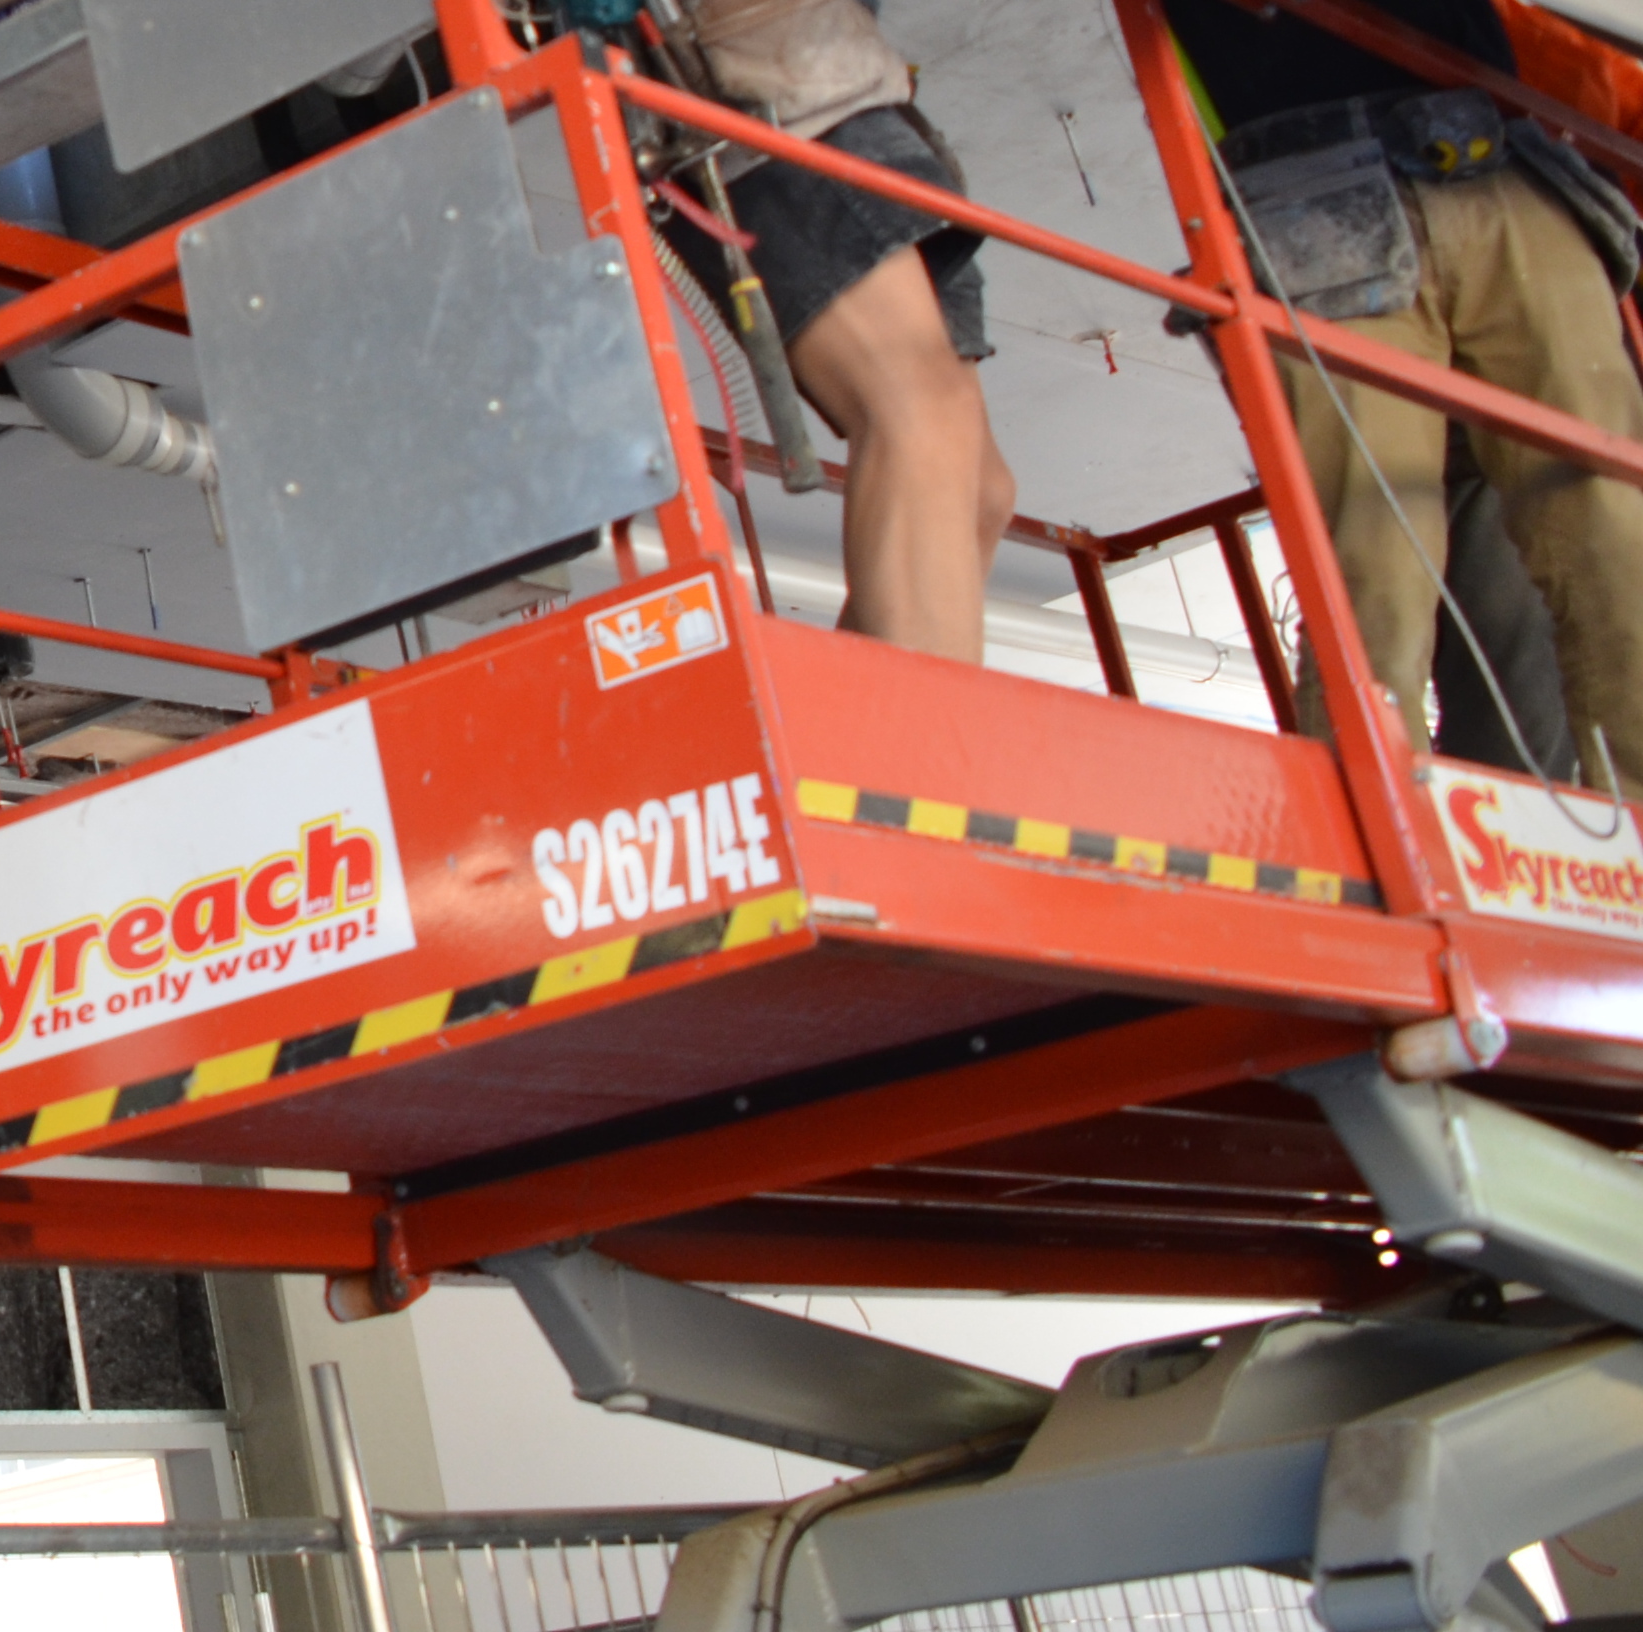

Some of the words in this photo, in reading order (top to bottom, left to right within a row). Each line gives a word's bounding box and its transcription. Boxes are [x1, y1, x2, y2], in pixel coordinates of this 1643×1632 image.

[532, 771, 781, 939] S26274E
[31, 1004, 96, 1037] the
[106, 971, 193, 1010] only
[204, 938, 297, 984] way
[307, 906, 378, 953] up!
